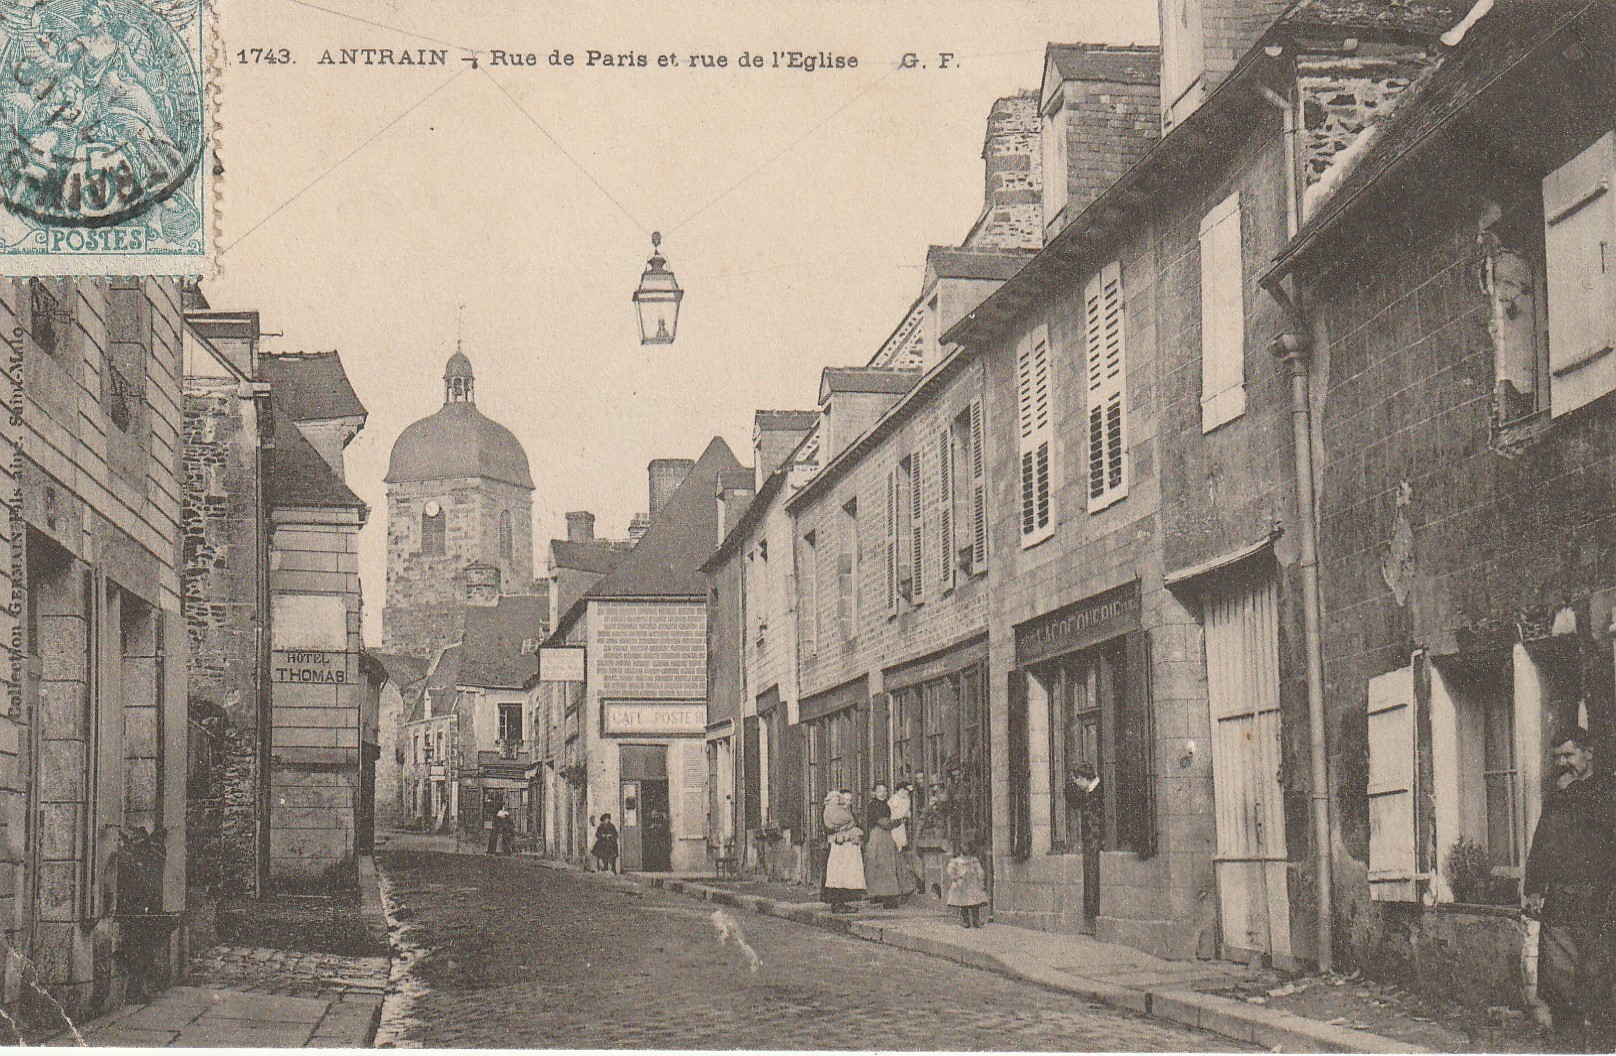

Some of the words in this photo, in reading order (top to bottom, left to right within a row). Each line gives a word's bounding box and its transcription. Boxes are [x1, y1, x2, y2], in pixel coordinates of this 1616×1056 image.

[52, 229, 143, 251] POSTES
[286, 653, 330, 664] HOTEL
[275, 667, 345, 682] THOMAS
